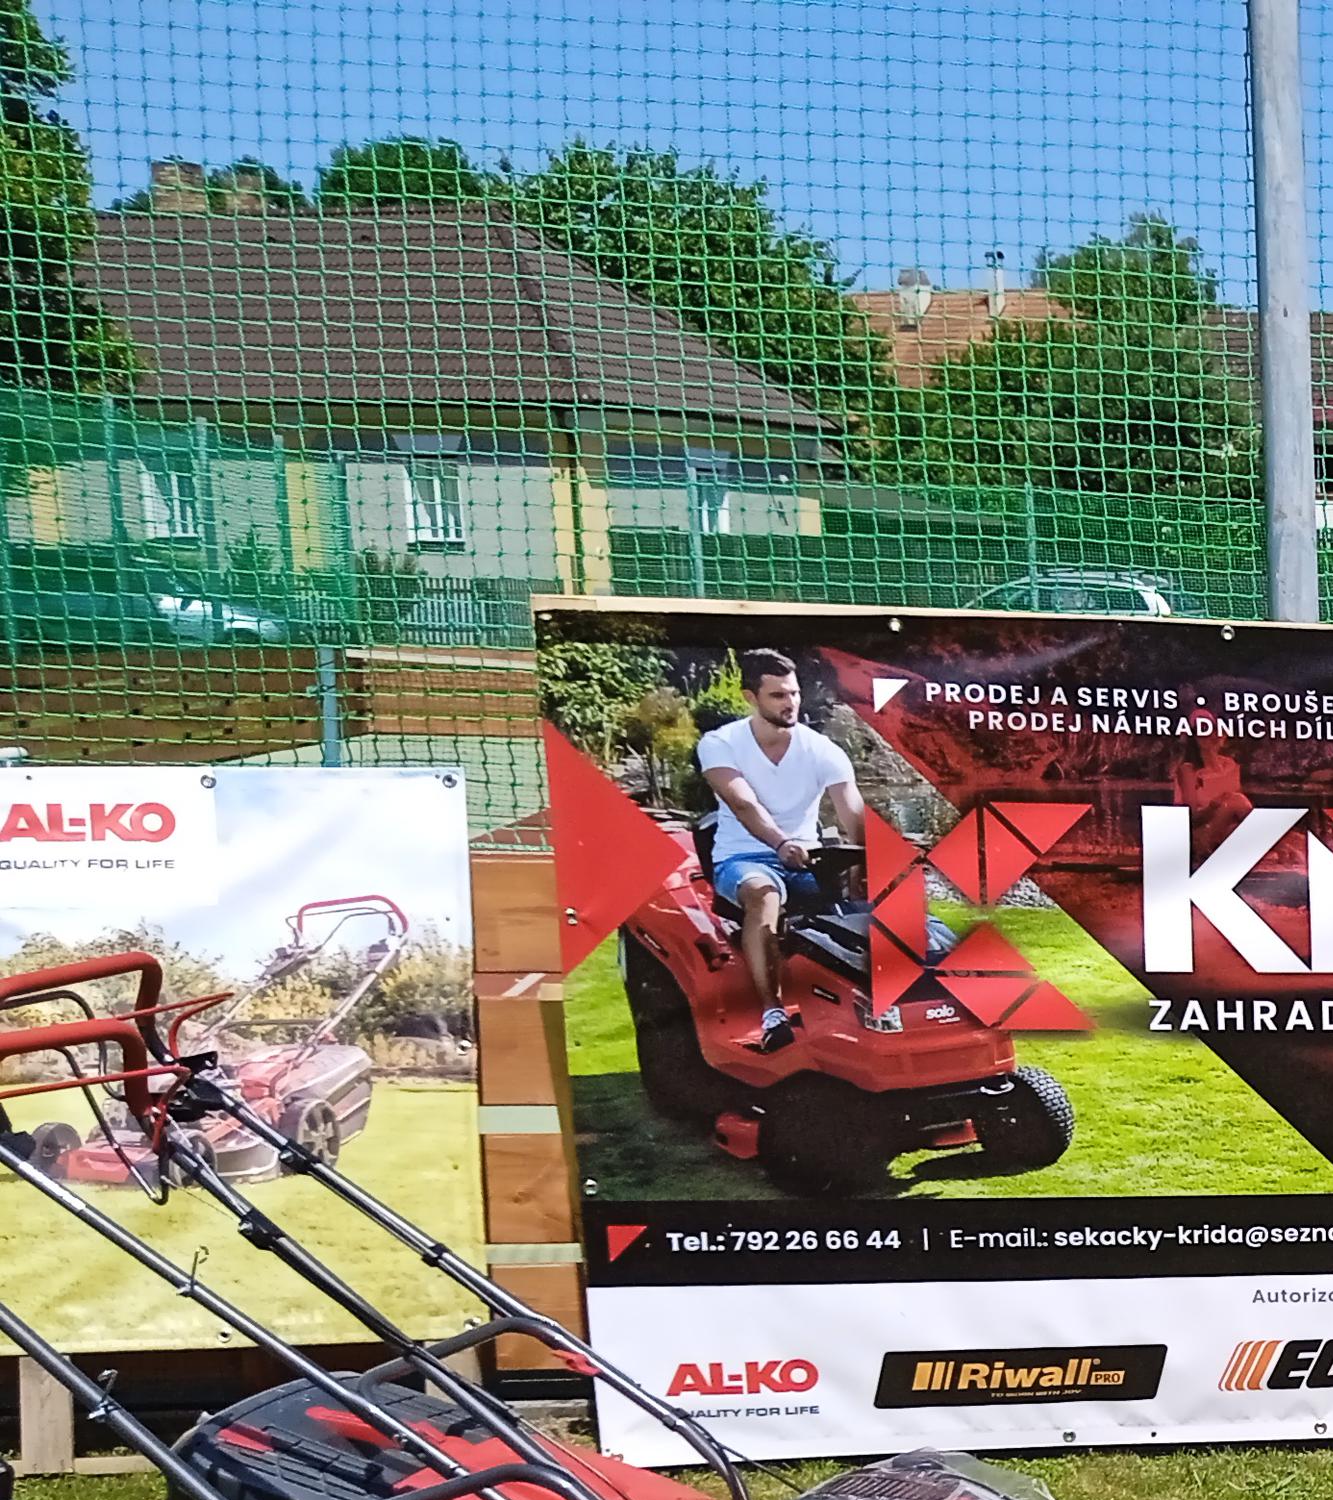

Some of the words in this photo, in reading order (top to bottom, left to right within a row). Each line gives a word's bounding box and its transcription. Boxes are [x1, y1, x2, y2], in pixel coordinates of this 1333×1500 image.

[925, 682, 1040, 705] PRODEJ
[1050, 687, 1068, 706] A
[1077, 687, 1179, 710] SERVIS
[968, 710, 1083, 733] PRODEJ
[1092, 710, 1287, 740] NÁHRADNÍCH
[0, 802, 176, 843] AL-KO
[0, 859, 81, 870] QUALITY
[87, 858, 129, 870] FOR
[135, 859, 175, 869] LIFE
[666, 1230, 727, 1252] Tel.:
[731, 1230, 780, 1251] 792
[785, 1230, 819, 1251] 26
[824, 1230, 860, 1250] 66
[865, 1230, 902, 1249] 44
[665, 1358, 819, 1397] AL-KO
[957, 1358, 1091, 1391] Riwall
[1094, 1373, 1121, 1384] PRO
[745, 1406, 781, 1417] FOR
[785, 1405, 820, 1416] LIFE
